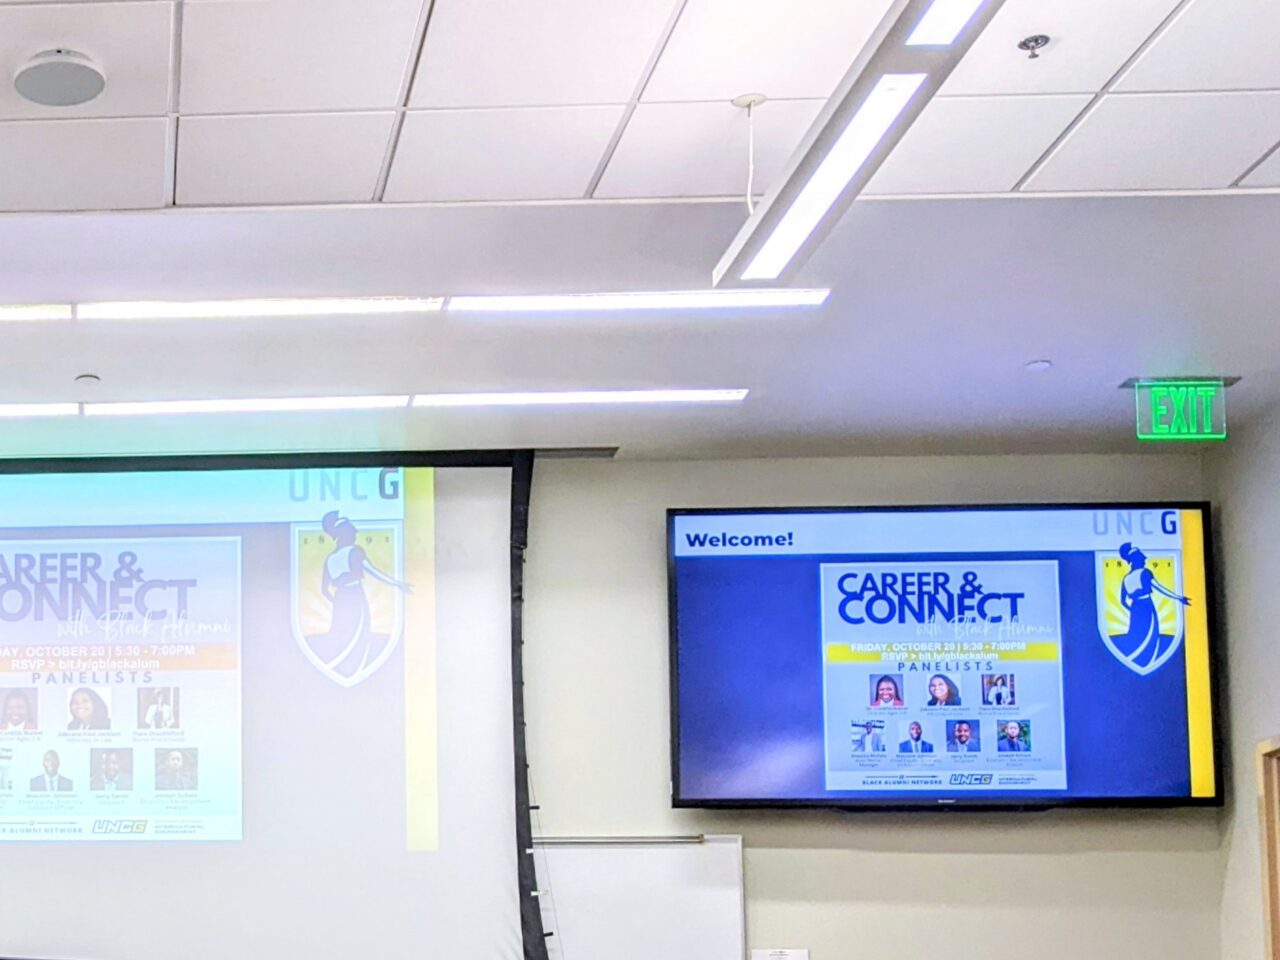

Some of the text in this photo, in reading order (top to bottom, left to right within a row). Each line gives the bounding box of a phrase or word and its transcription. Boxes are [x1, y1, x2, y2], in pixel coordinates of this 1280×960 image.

[1151, 387, 1216, 433] EXIT
[288, 467, 400, 501] UNCG
[1092, 510, 1177, 537] UNCG
[685, 531, 794, 548] Welcome!
[113, 551, 145, 583] &
[837, 571, 984, 596] CAREER &
[837, 591, 1025, 625] CONNECT
[28, 646, 89, 658] OCTOBER
[90, 646, 106, 657] 20
[115, 645, 141, 657] 5:30
[150, 645, 196, 657] 7:00PM
[851, 644, 891, 653] FRIDAY,
[892, 643, 942, 652] OCTOBER
[943, 643, 956, 651] 20
[962, 642, 983, 651] 5:30
[990, 642, 1026, 651] 7:00PM
[11, 659, 46, 670] RSVP
[881, 652, 909, 662] RSVP
[897, 661, 994, 672] PANELISTS
[31, 671, 153, 685] PANELISTS
[949, 773, 994, 786] UNCG
[92, 819, 148, 834] UNCG
